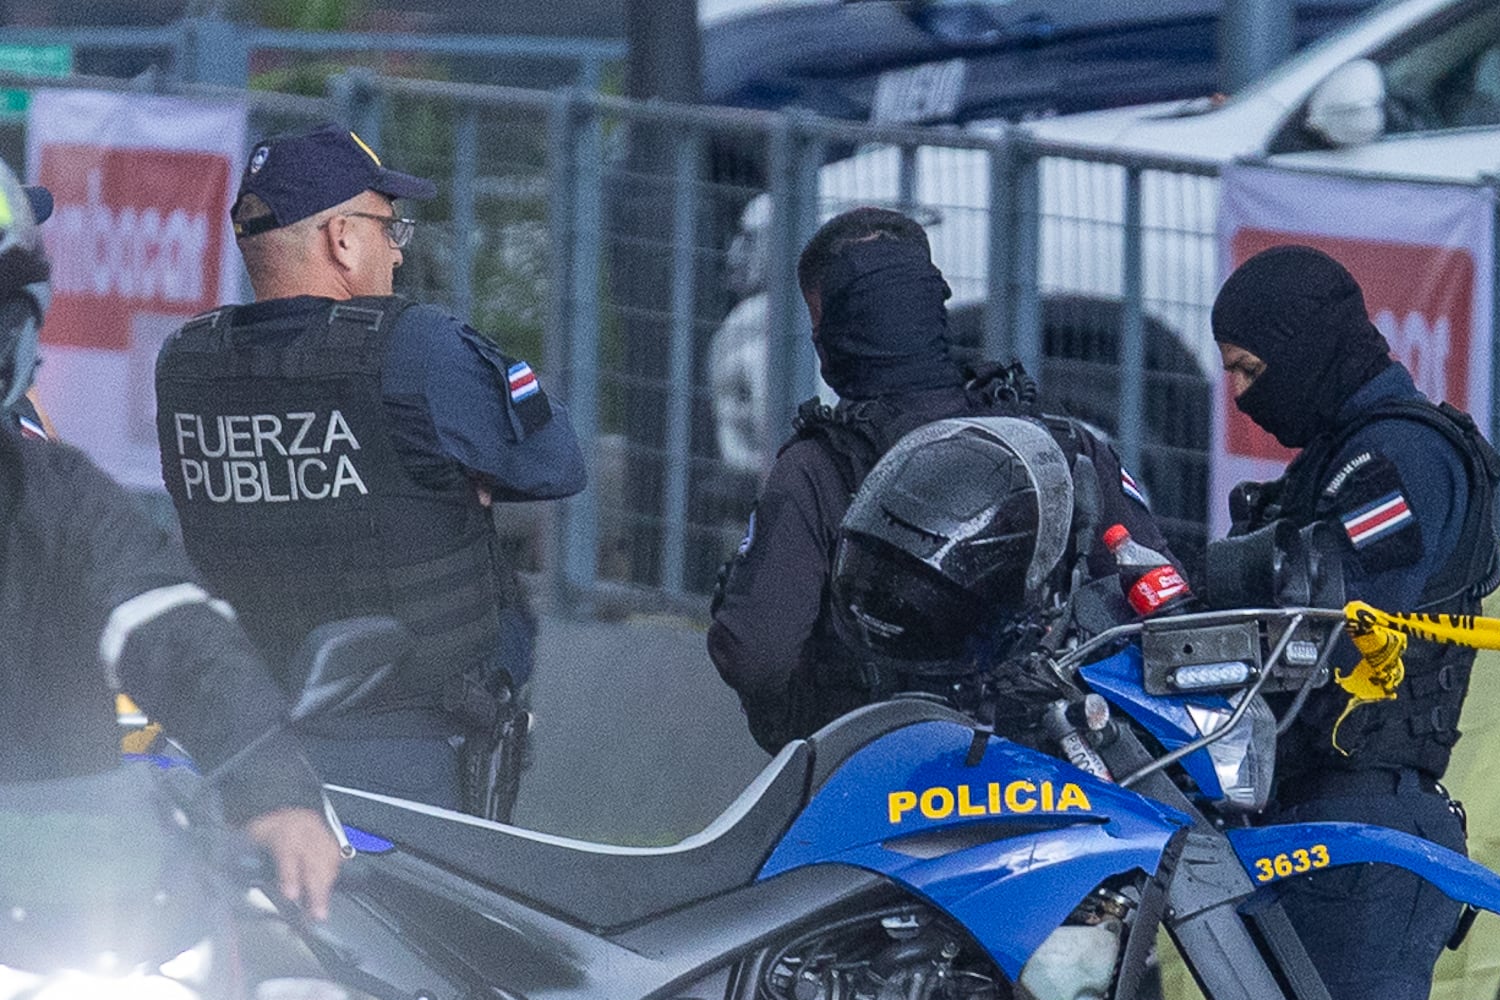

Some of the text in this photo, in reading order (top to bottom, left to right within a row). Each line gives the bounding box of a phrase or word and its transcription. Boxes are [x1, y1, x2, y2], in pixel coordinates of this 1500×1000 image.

[174, 410, 362, 457] FUERZA
[180, 454, 369, 502] PUBLICA
[888, 780, 1092, 824] POLICIA
[1255, 844, 1331, 882] 3633
